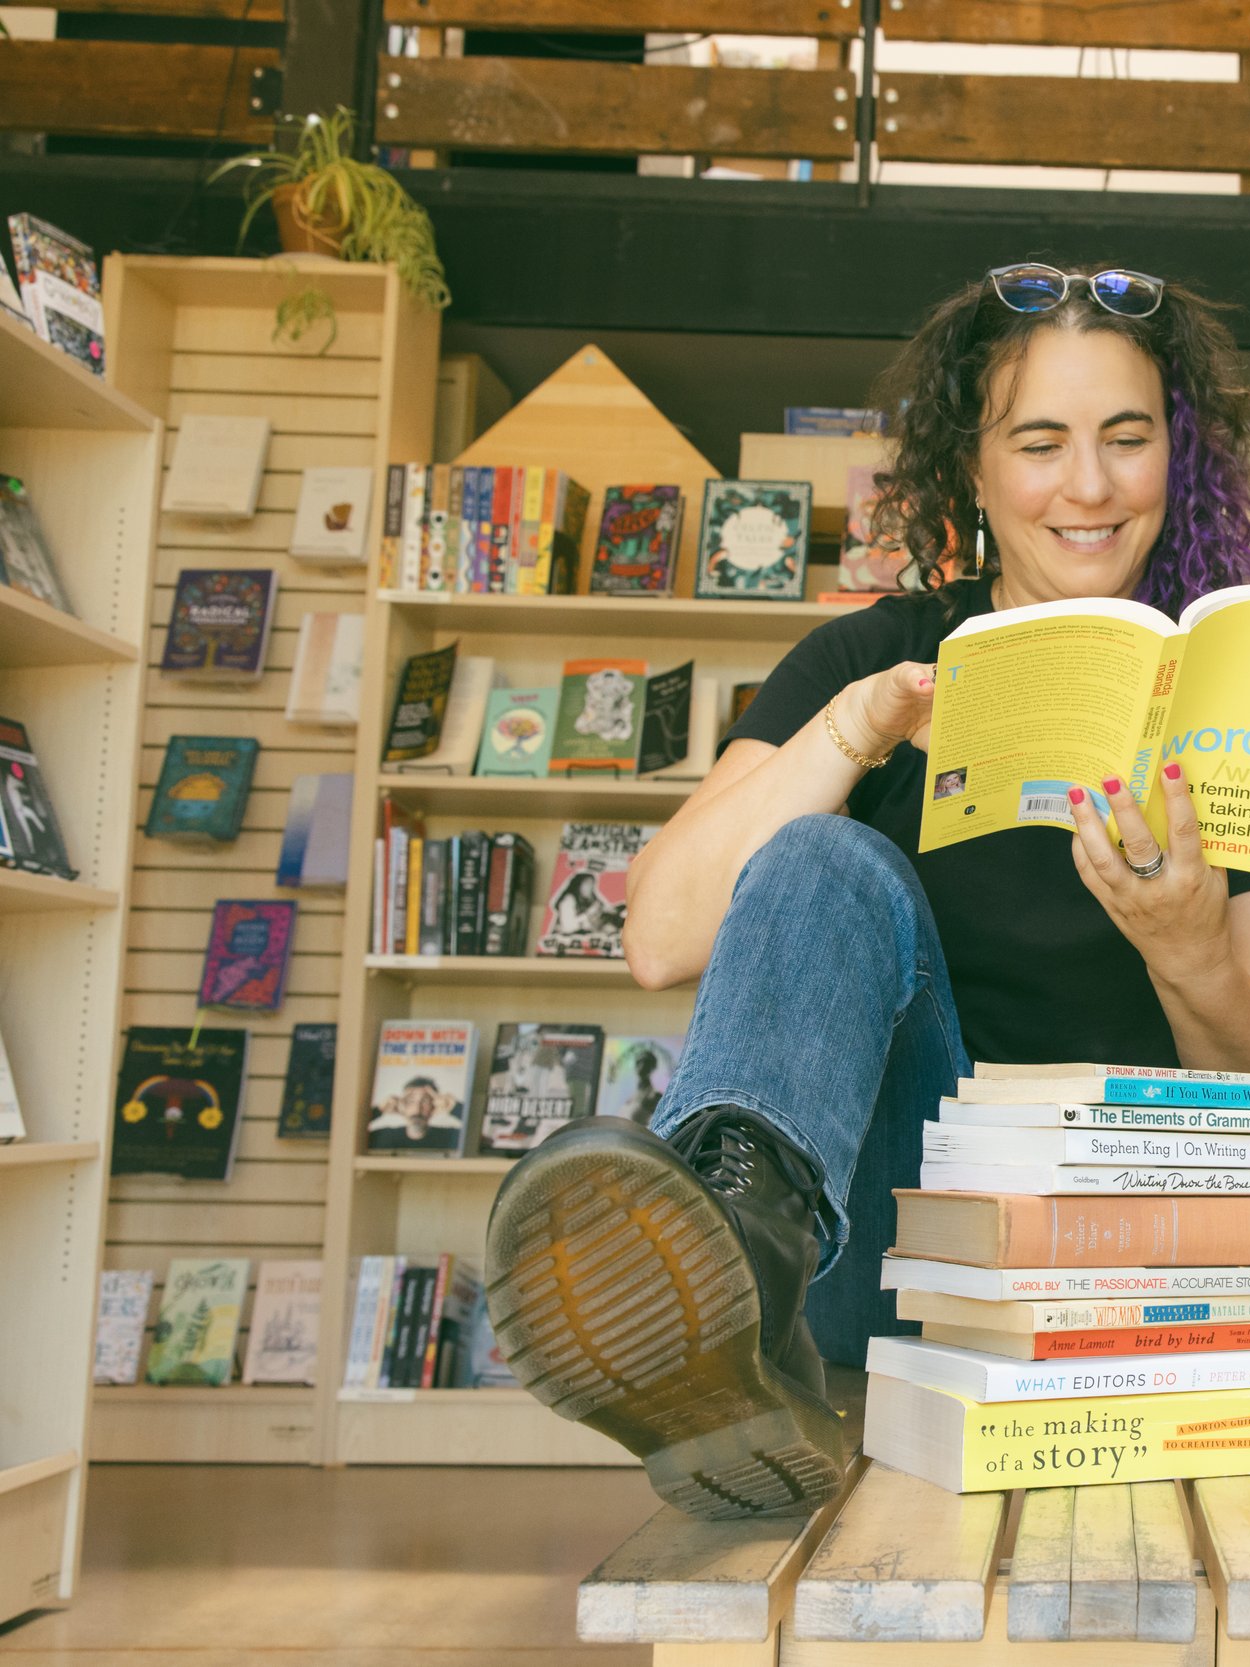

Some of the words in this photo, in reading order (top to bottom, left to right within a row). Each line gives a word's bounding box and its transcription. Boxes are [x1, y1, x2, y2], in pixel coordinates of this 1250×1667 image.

[1152, 664, 1166, 697] montell
[1162, 659, 1177, 696] amanda
[1130, 748, 1152, 804] wordsl
[1106, 1066, 1135, 1077] STRUNK
[1138, 1068, 1153, 1079] AND
[1155, 1069, 1178, 1080] WHITE
[1187, 1070, 1212, 1080] Elements
[1216, 1071, 1231, 1081] Style
[1110, 1083, 1137, 1091] BRENDA
[1165, 1086, 1175, 1099] If
[1179, 1086, 1199, 1100] You
[1201, 1087, 1227, 1101] Want
[1231, 1091, 1241, 1102] to
[521, 1098, 573, 1118] DESERT
[1090, 1108, 1117, 1124] The
[1122, 1109, 1186, 1126] Elements
[1189, 1111, 1203, 1126] of
[1091, 1138, 1139, 1157] Stephen
[1143, 1141, 1171, 1158] King
[1184, 1141, 1202, 1155] On
[1204, 1142, 1246, 1160] Writing
[1073, 1176, 1099, 1185] Goldberg
[1113, 1170, 1167, 1191] Writing
[1168, 1171, 1204, 1190] Down
[1204, 1174, 1223, 1189] the
[1064, 1231, 1073, 1241] A
[1087, 1221, 1100, 1250] Diary
[1012, 1281, 1044, 1291] CAROL
[1045, 1281, 1061, 1291] BLY
[1066, 1278, 1090, 1290] THE
[1171, 1276, 1233, 1289] ACCURATE
[1093, 1306, 1120, 1327] WILD
[1119, 1304, 1143, 1325] MIND
[1211, 1304, 1245, 1317] NATALIE
[1048, 1339, 1076, 1351] Anne
[1079, 1337, 1114, 1350] Lamott
[1135, 1335, 1162, 1348] bird
[1167, 1335, 1182, 1348] by
[1188, 1332, 1215, 1345] bird
[1016, 1377, 1066, 1392] WHAT
[1073, 1373, 1146, 1390] EDITORS
[1153, 1371, 1177, 1386] DO
[1210, 1371, 1246, 1383] PETER
[1043, 1411, 1145, 1441] making
[1179, 1425, 1185, 1435] A
[1187, 1420, 1227, 1433] NORTON
[1165, 1440, 1178, 1449] TO
[1181, 1439, 1226, 1449] CREATIVE
[986, 1452, 1007, 1473] of
[1015, 1459, 1024, 1472] a
